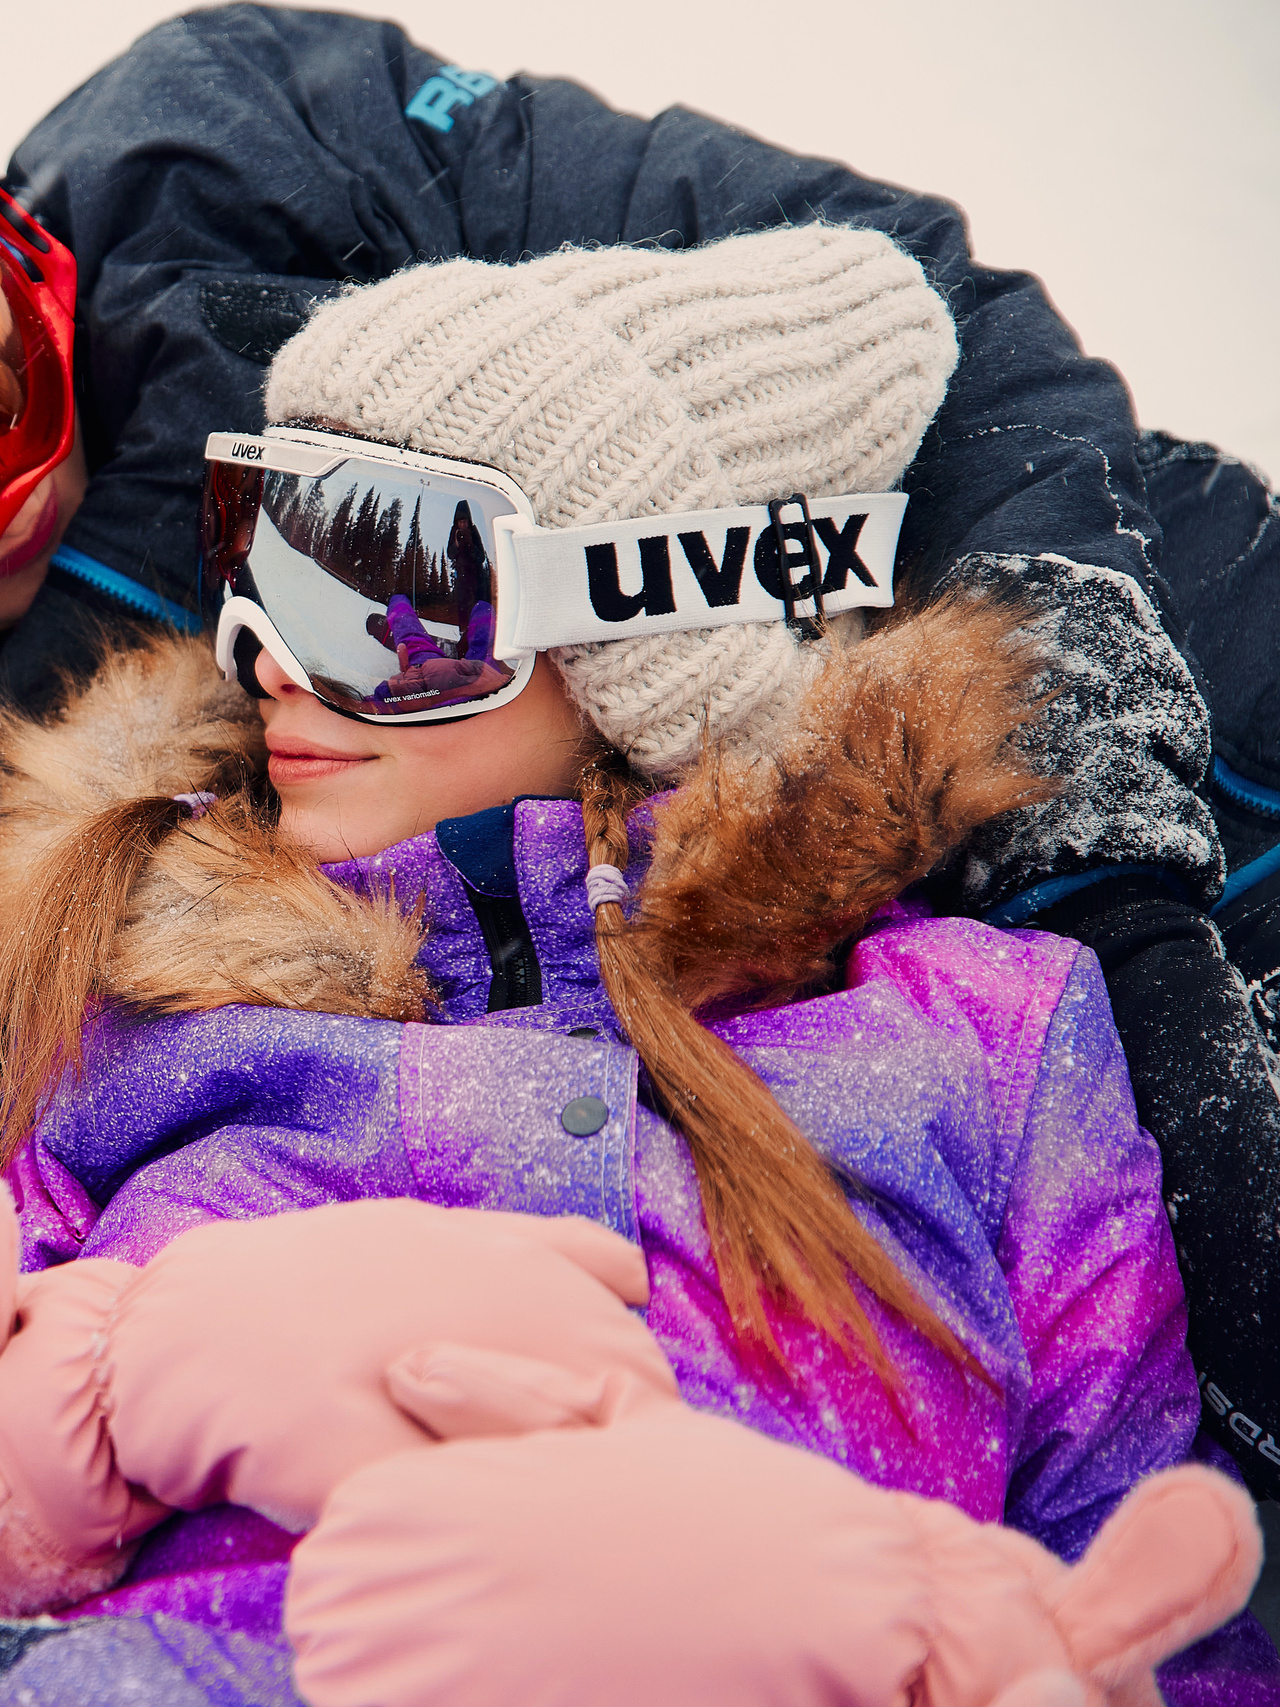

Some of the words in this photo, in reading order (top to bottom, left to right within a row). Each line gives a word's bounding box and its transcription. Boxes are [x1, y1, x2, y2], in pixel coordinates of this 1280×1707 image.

[231, 441, 266, 461] uvex
[584, 512, 879, 623] uvex
[383, 695, 402, 704] uvex
[402, 688, 441, 701] variomatic
